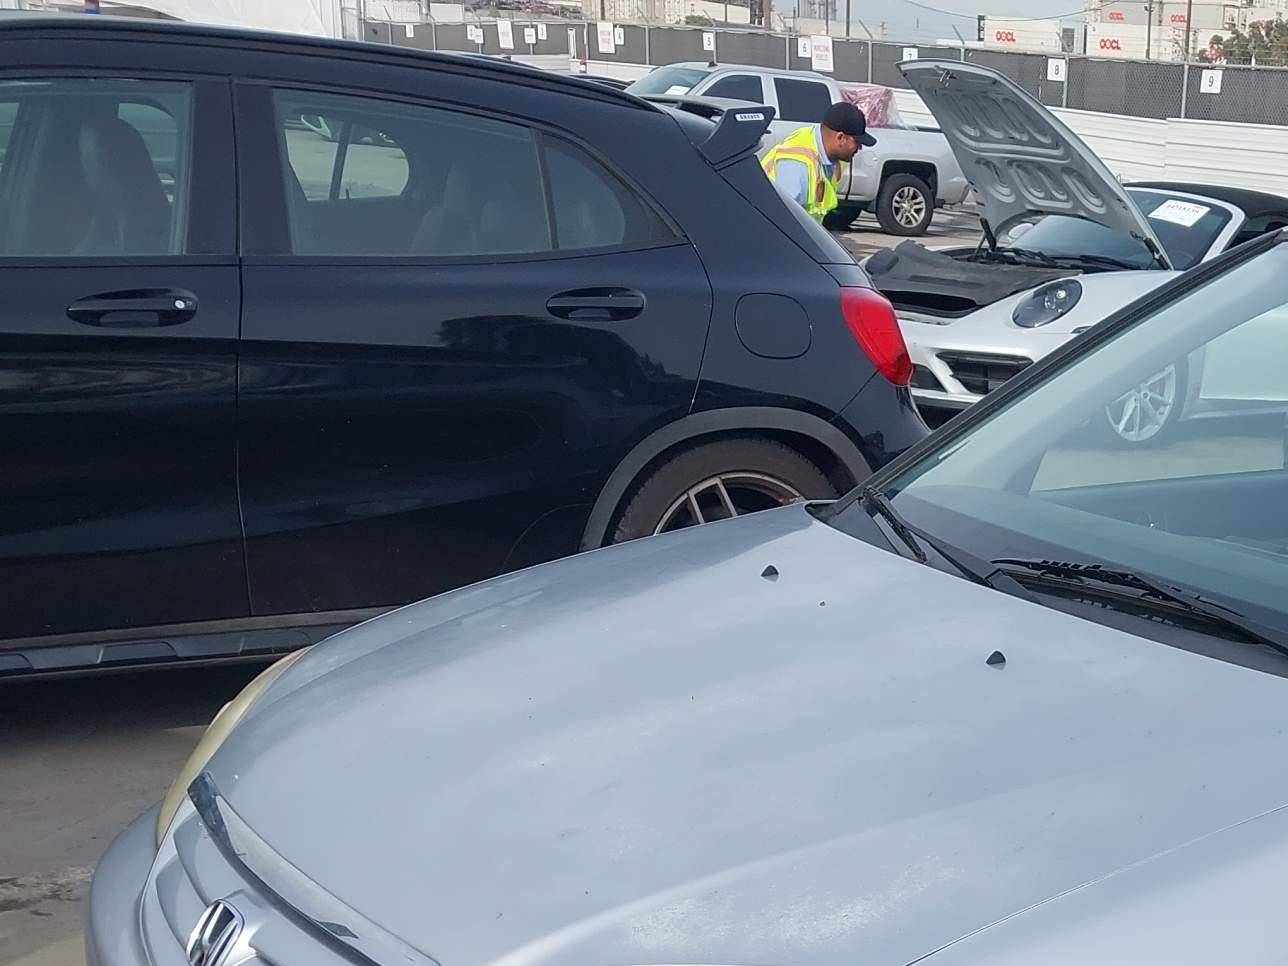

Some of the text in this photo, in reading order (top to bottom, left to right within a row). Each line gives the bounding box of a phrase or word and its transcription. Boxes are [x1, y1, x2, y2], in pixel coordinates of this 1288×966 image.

[995, 31, 1016, 42] OOCL
[1100, 38, 1121, 50] OOCL
[1053, 65, 1060, 76] 8
[1208, 75, 1214, 88] 9
